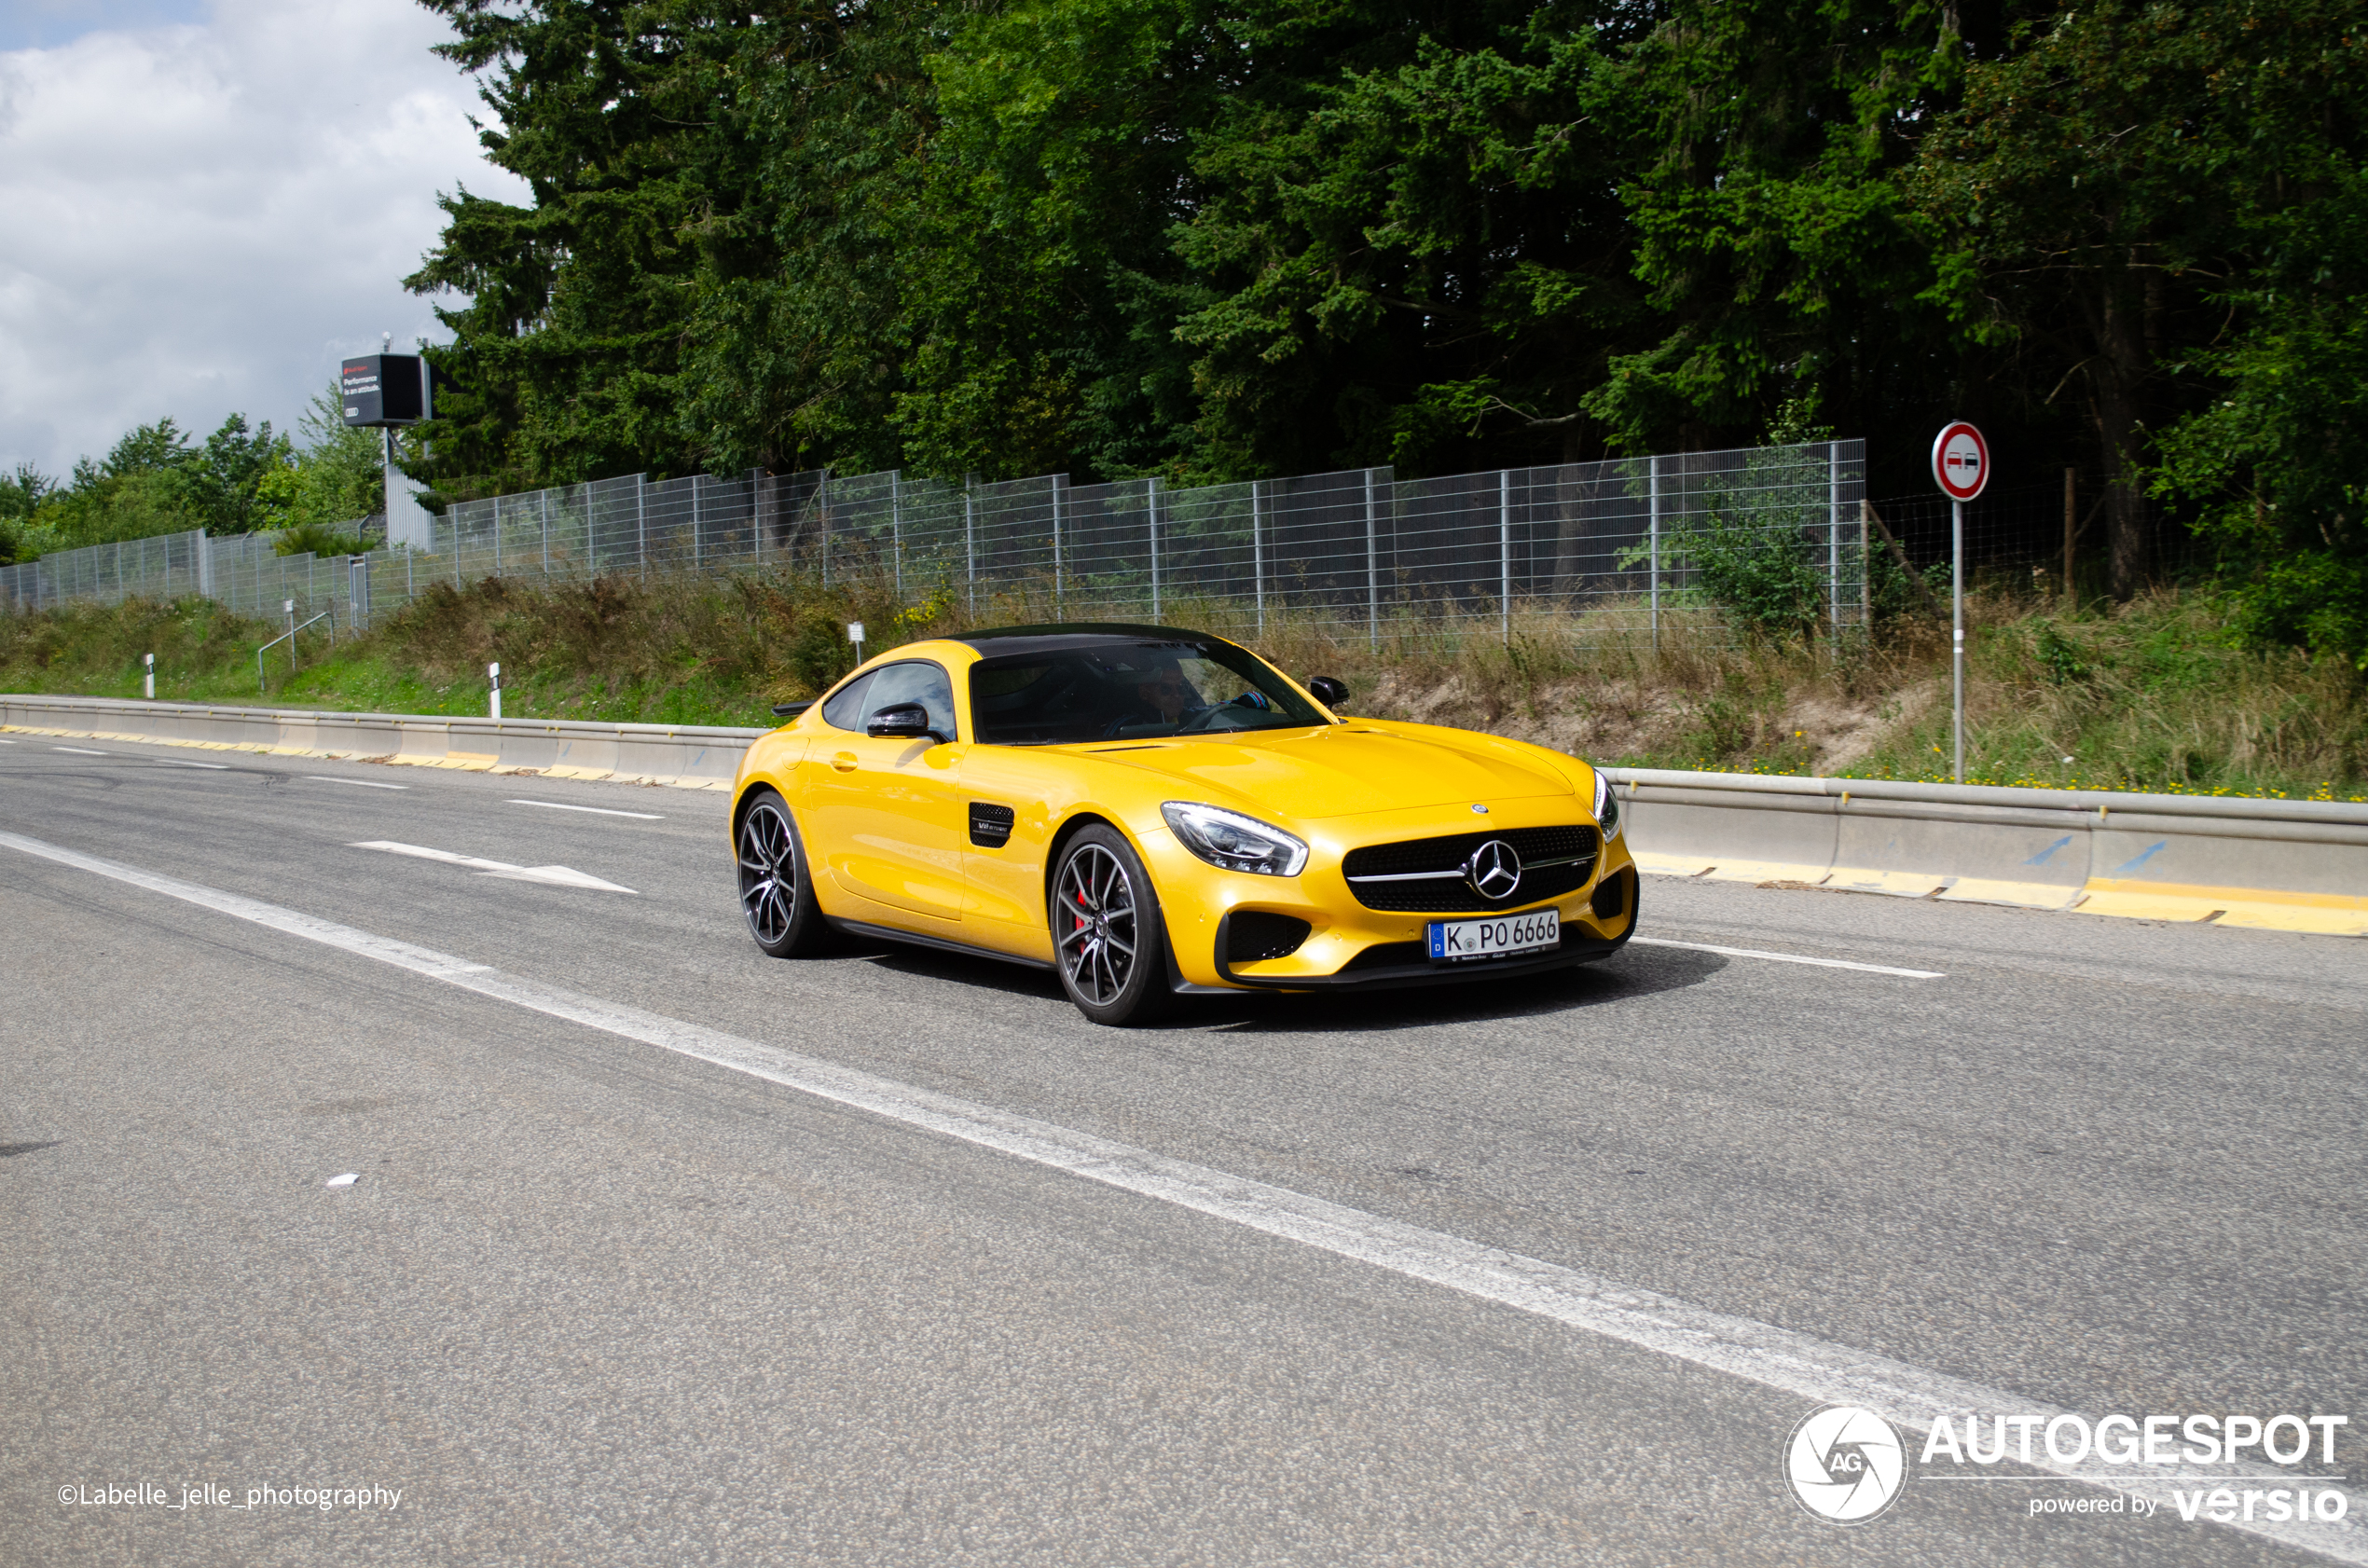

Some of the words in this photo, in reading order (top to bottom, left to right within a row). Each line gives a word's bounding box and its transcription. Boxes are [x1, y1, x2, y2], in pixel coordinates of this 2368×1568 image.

[344, 376, 378, 385] Performance
[358, 384, 380, 393] attitude.
[1447, 926, 1462, 951] K
[1480, 922, 1508, 948] PO
[1513, 915, 1557, 943] 6666
[1435, 943, 1441, 952] D
